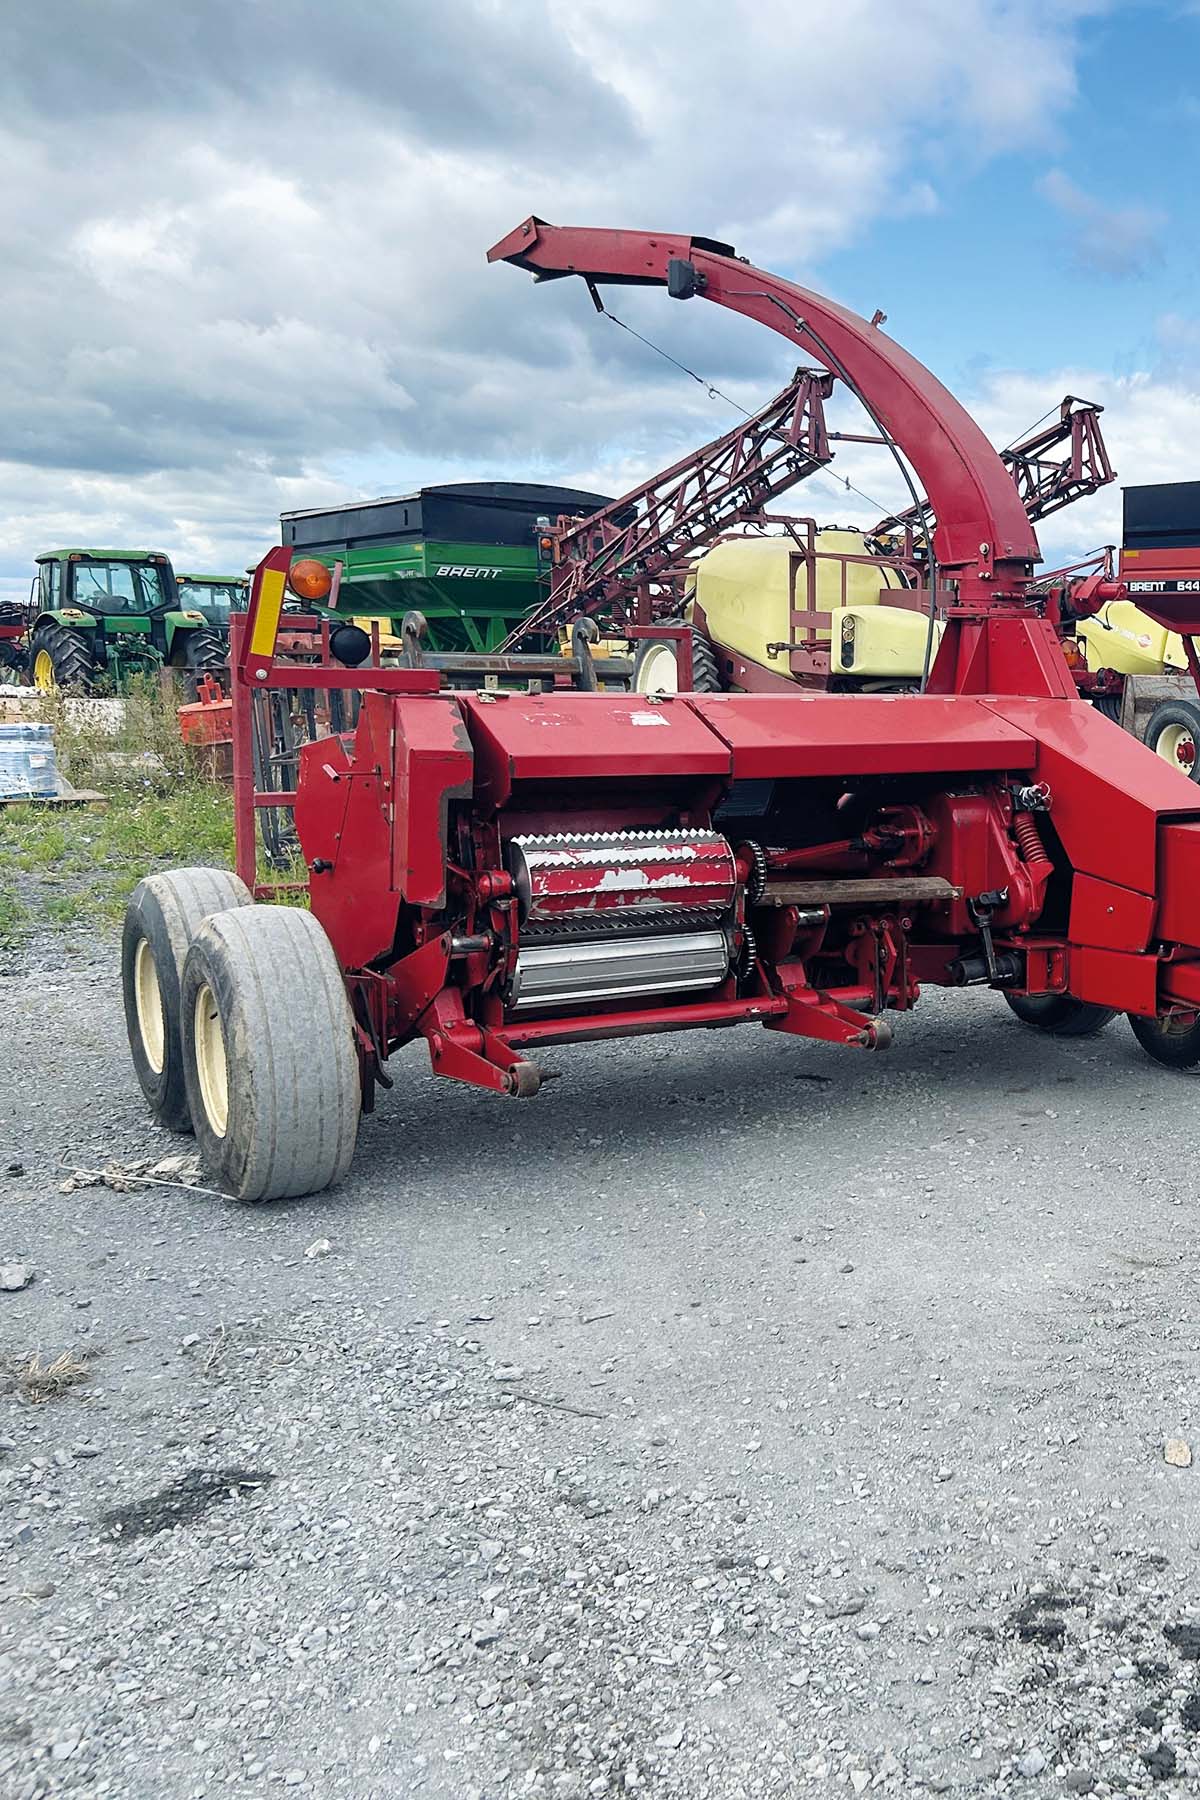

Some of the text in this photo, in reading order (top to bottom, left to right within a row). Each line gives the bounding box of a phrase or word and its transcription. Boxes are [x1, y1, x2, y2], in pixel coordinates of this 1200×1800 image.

[436, 566, 502, 578] BRENT
[1129, 581, 1200, 592] BRENT 644
